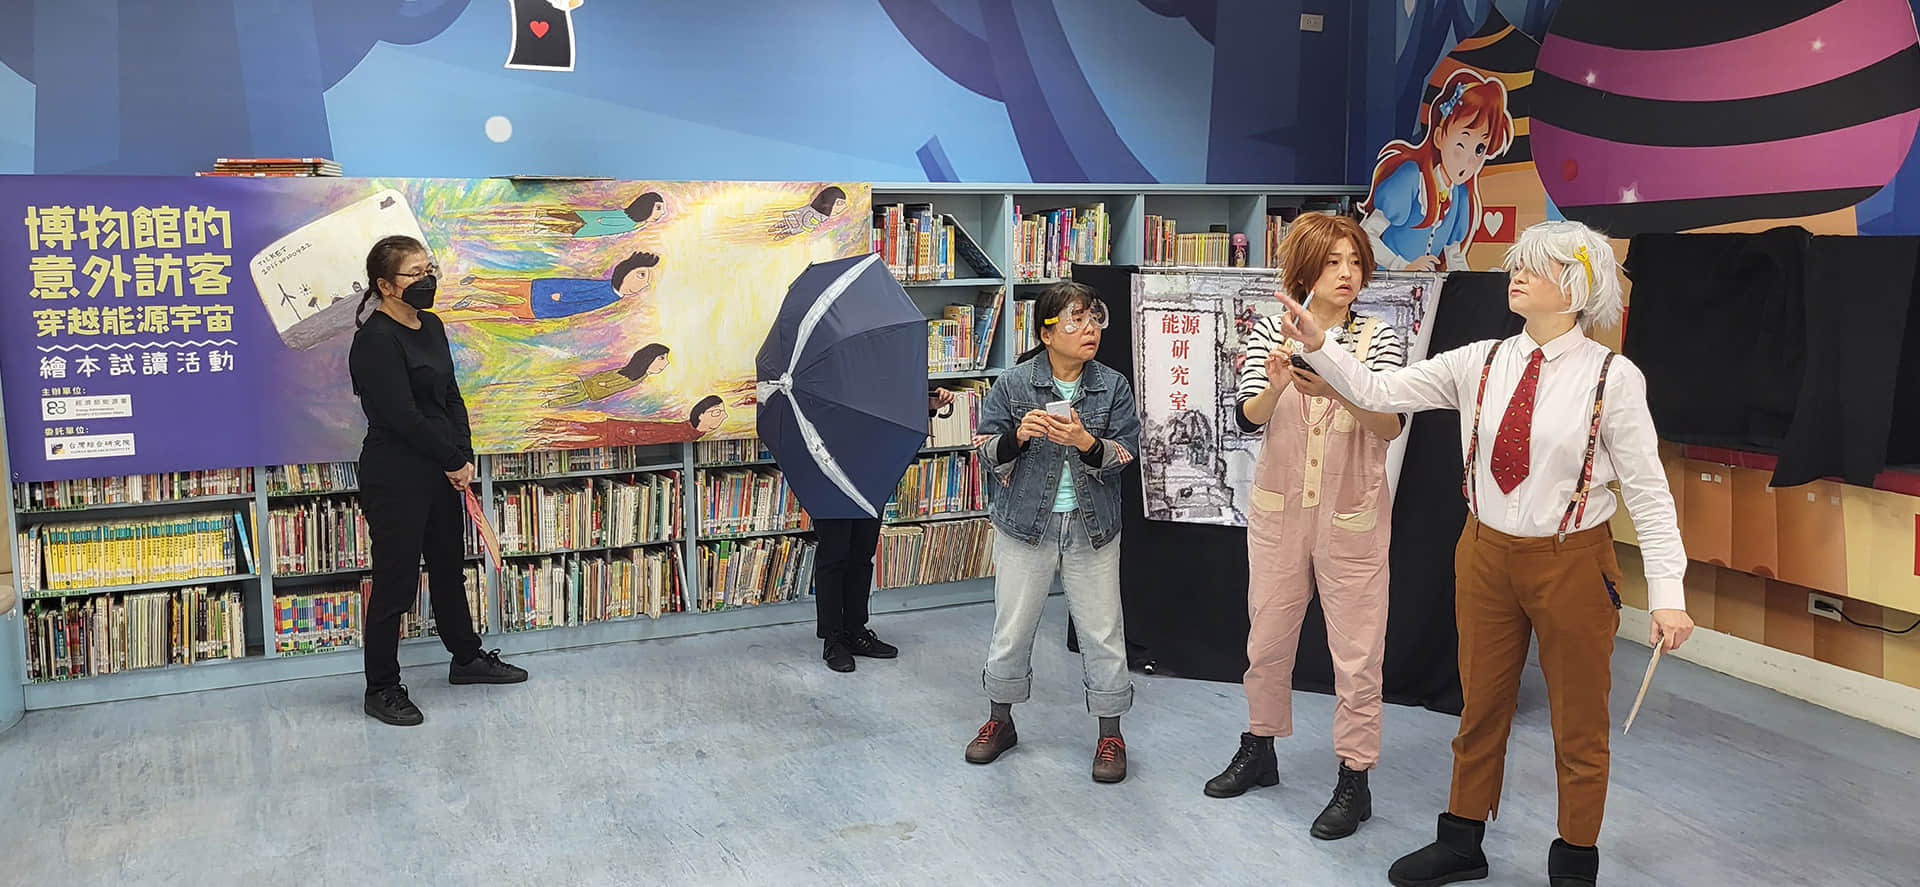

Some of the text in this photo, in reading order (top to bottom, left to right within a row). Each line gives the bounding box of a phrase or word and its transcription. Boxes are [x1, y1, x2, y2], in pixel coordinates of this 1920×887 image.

[25, 205, 232, 251] 博物館的
[258, 245, 287, 266] TICKET
[29, 252, 232, 300] 意外訪客
[33, 304, 234, 337] 穿越能源宇宙
[1162, 314, 1200, 335] 能源
[40, 350, 234, 380] 繪本試讀活動
[1169, 340, 1190, 412] 研究室
